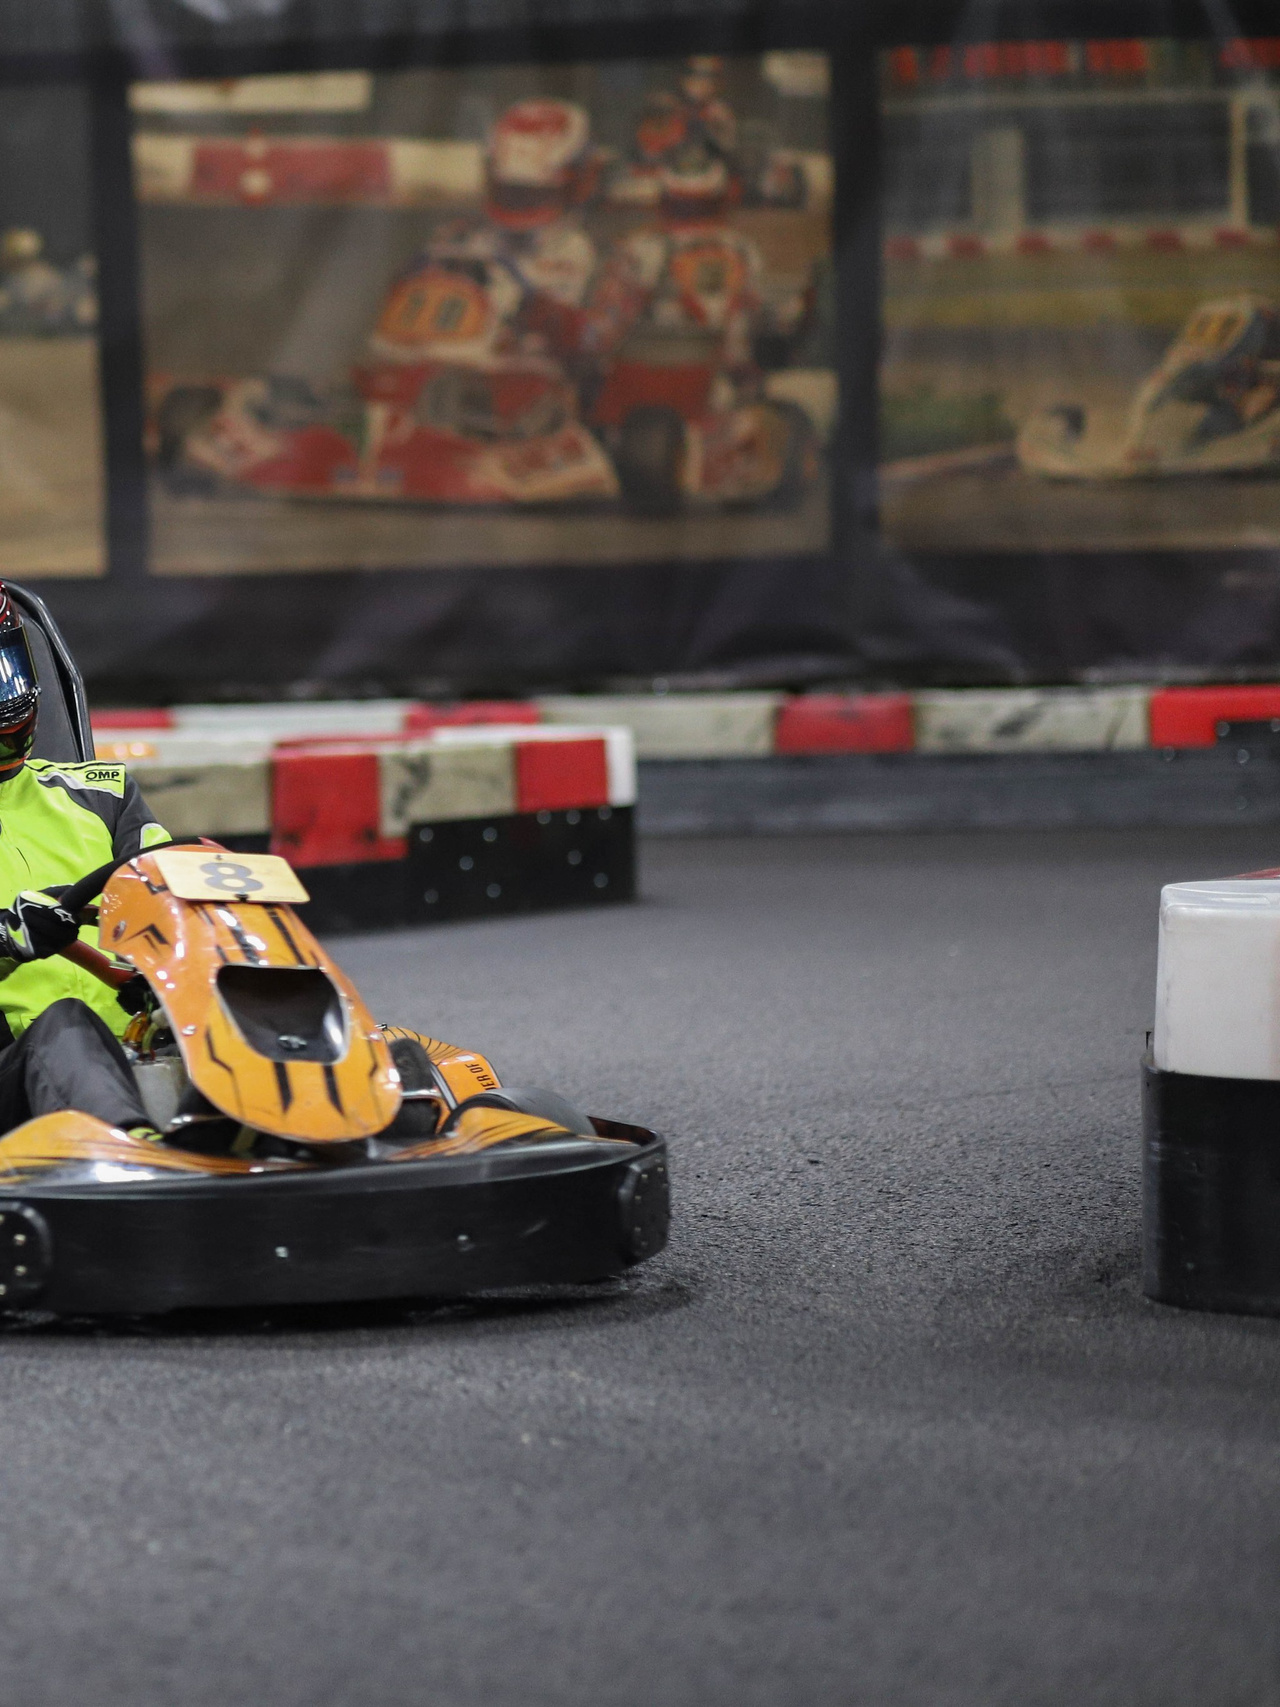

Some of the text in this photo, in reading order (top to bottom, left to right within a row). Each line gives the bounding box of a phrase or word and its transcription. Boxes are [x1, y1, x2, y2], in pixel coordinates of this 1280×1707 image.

[85, 770, 120, 781] OMP
[199, 862, 264, 893] 8
[465, 1063, 484, 1073] OF
